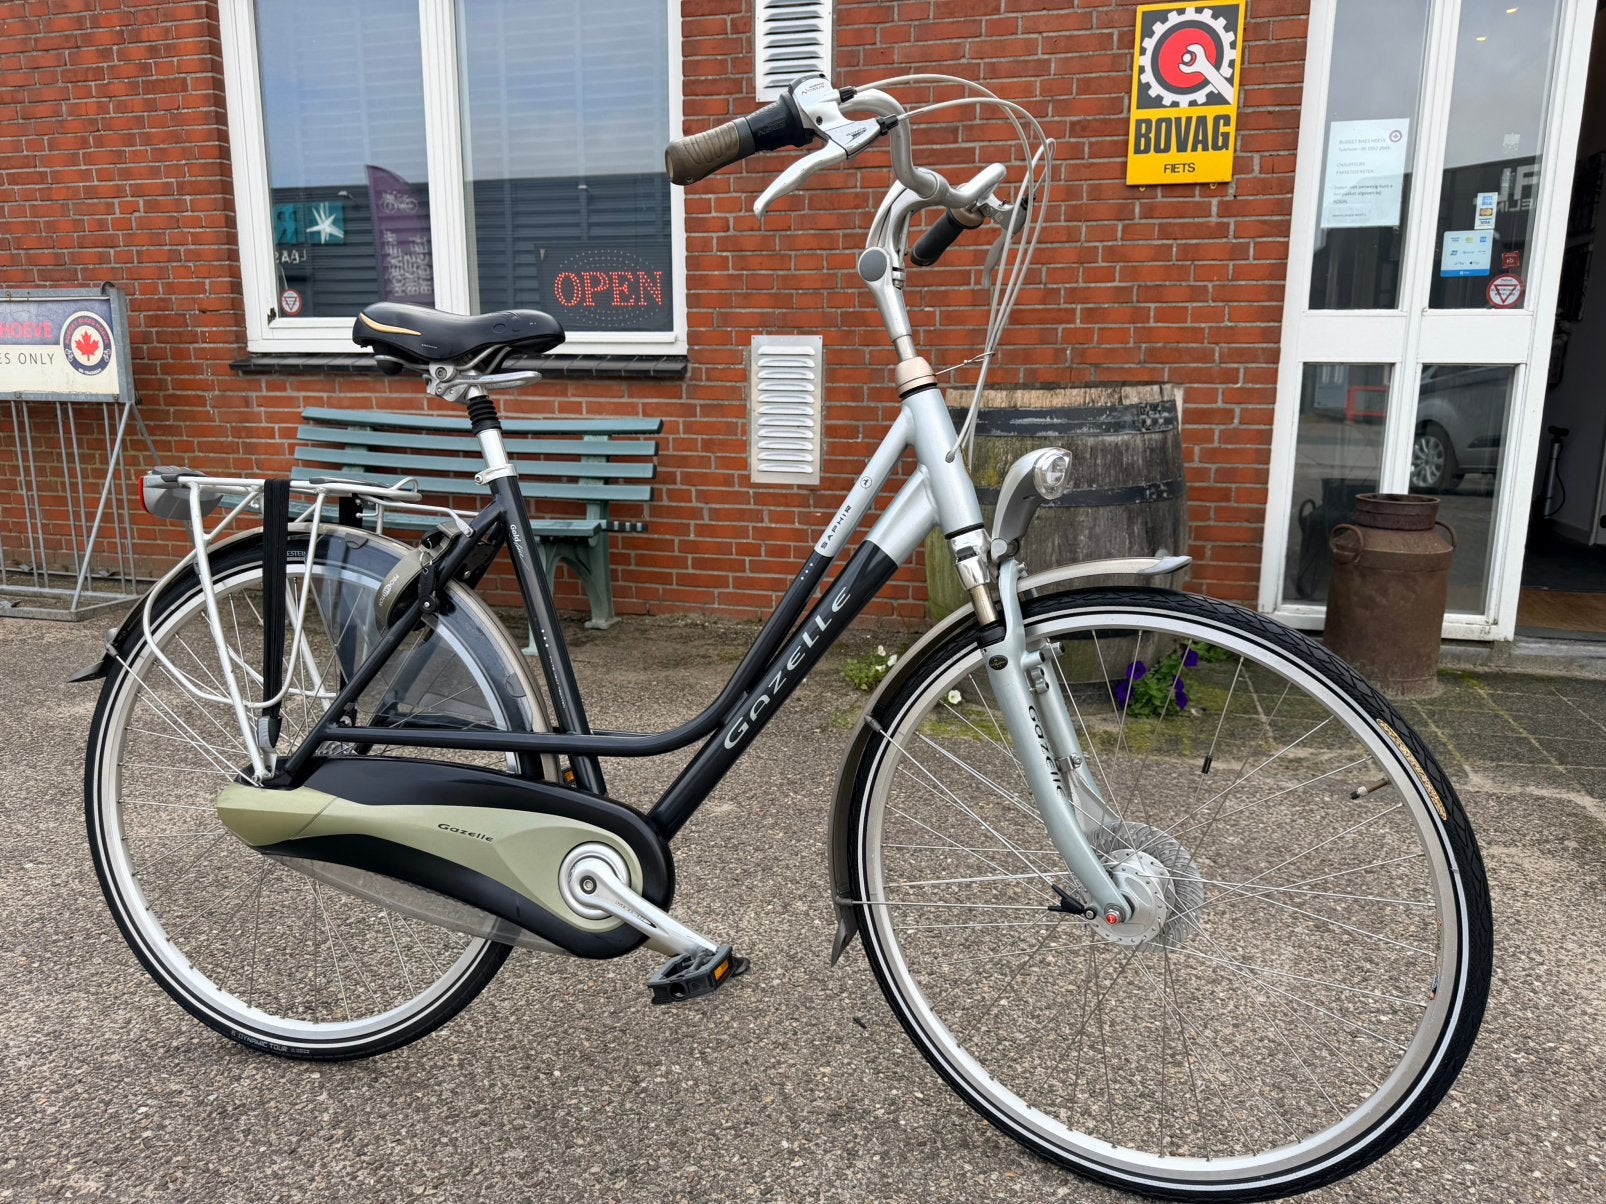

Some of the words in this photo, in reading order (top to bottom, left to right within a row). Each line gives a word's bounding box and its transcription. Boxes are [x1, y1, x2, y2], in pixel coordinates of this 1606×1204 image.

[1133, 114, 1232, 155] BOVAG
[1163, 162, 1196, 174] FIETS
[554, 271, 663, 307] OPEN
[0, 321, 54, 339] HOEVE
[18, 352, 55, 365] ONLY
[820, 504, 852, 549] SAPHIR
[724, 586, 851, 750] GAZELLE
[1028, 705, 1066, 797] Gazelle
[437, 823, 494, 842] Gazelle
[237, 1032, 268, 1048] DYNAMIC
[269, 1042, 288, 1052] TOUR
